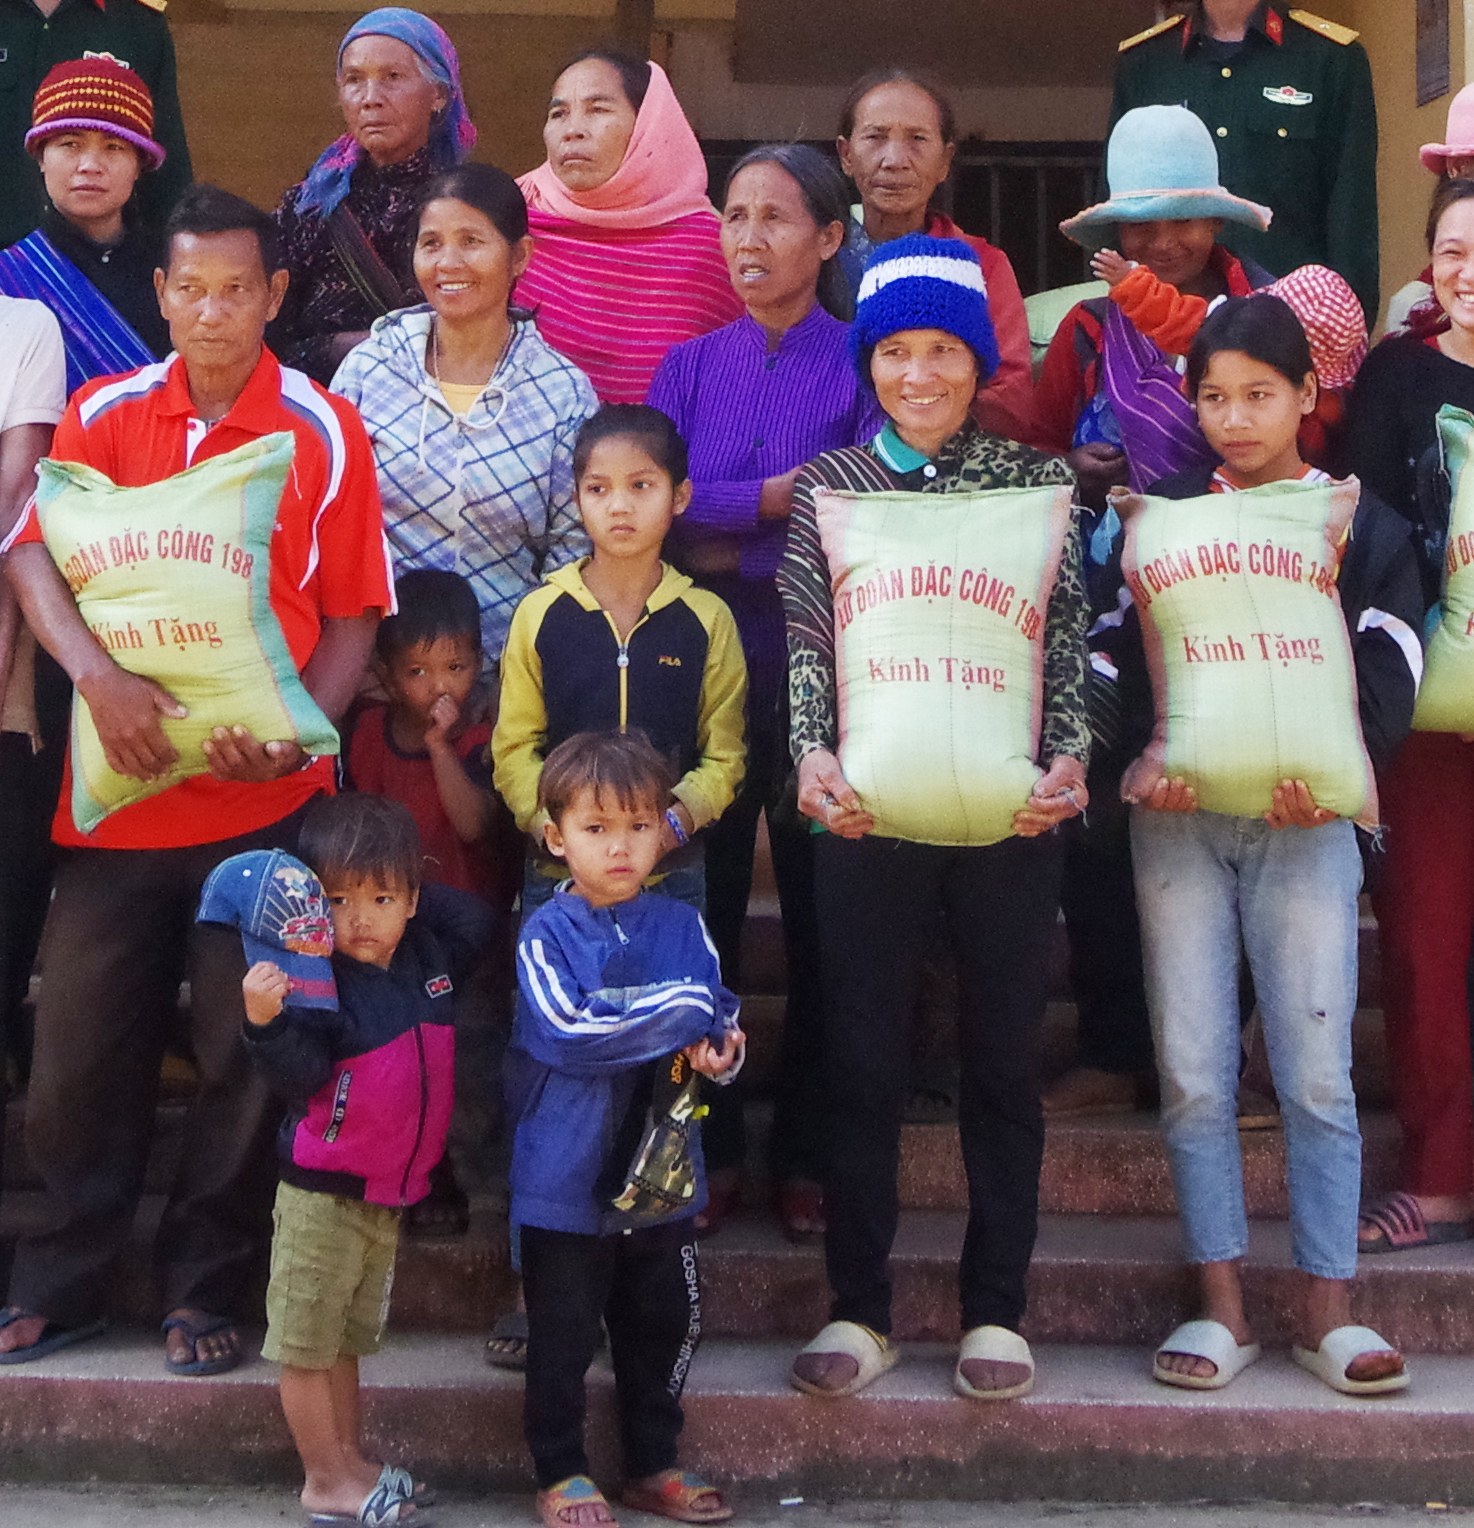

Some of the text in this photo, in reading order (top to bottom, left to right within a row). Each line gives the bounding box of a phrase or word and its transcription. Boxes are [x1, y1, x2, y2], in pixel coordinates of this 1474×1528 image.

[109, 526, 149, 571] ĐẶC
[157, 524, 214, 564] CÔNG
[222, 542, 253, 579] 198
[1144, 548, 1197, 594] ĐOÀN
[1197, 537, 1240, 582] ĐẶC
[1248, 538, 1303, 583] CÔNG
[856, 568, 904, 614] ĐOÀN
[911, 560, 952, 604] ĐẶC
[959, 567, 1015, 618] CÔNG
[148, 616, 222, 652] Tặng
[1183, 632, 1324, 668] Kính Tặng
[868, 656, 1006, 693] Kính Tặng
[680, 1245, 700, 1303] GOSHA
